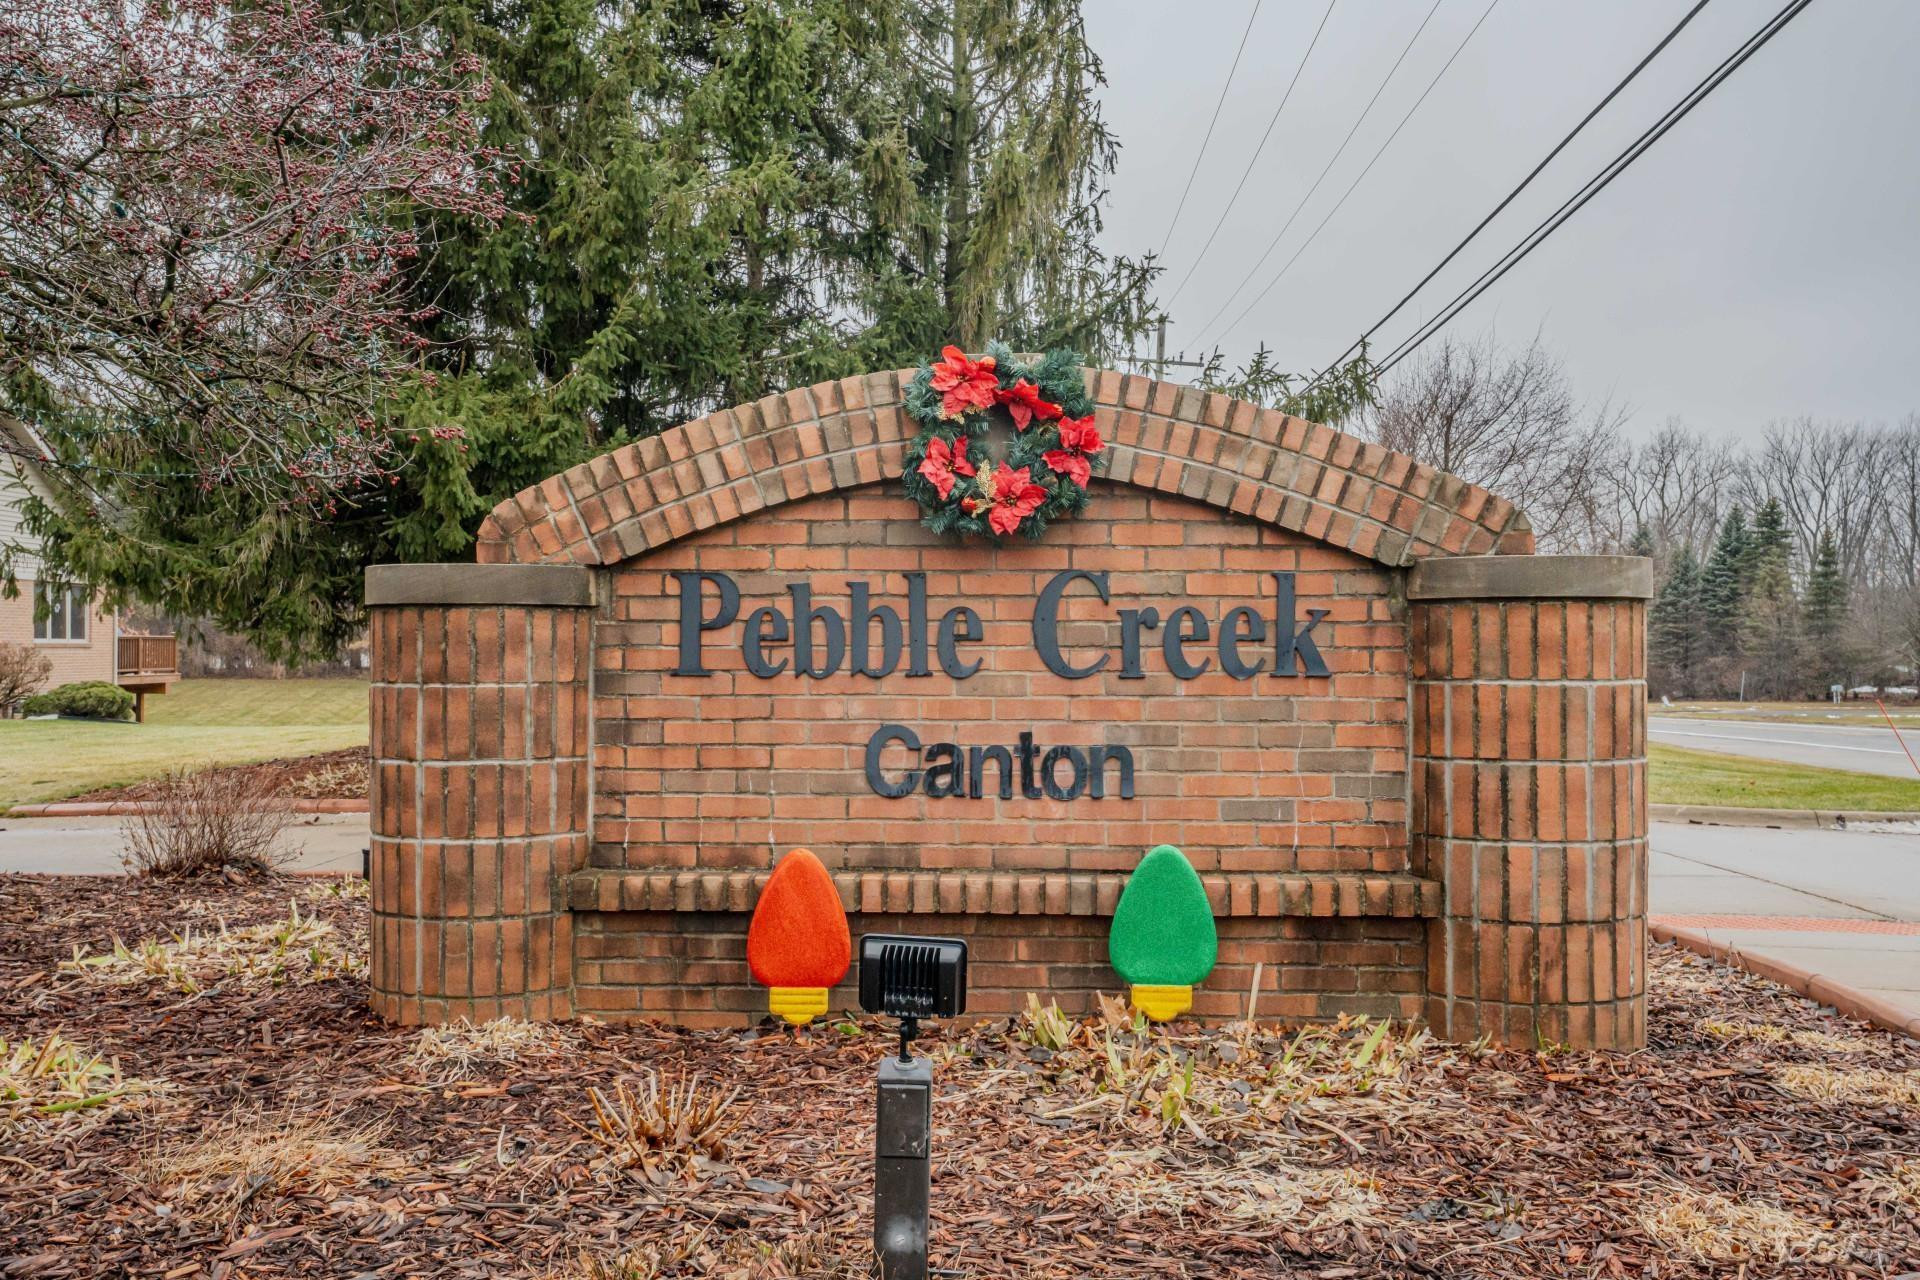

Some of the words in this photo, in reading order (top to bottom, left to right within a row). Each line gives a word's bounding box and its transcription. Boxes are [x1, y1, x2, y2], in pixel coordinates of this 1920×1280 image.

[670, 571, 984, 680] Pebble
[1032, 569, 1331, 680] Creek
[864, 723, 1135, 801] Canton
